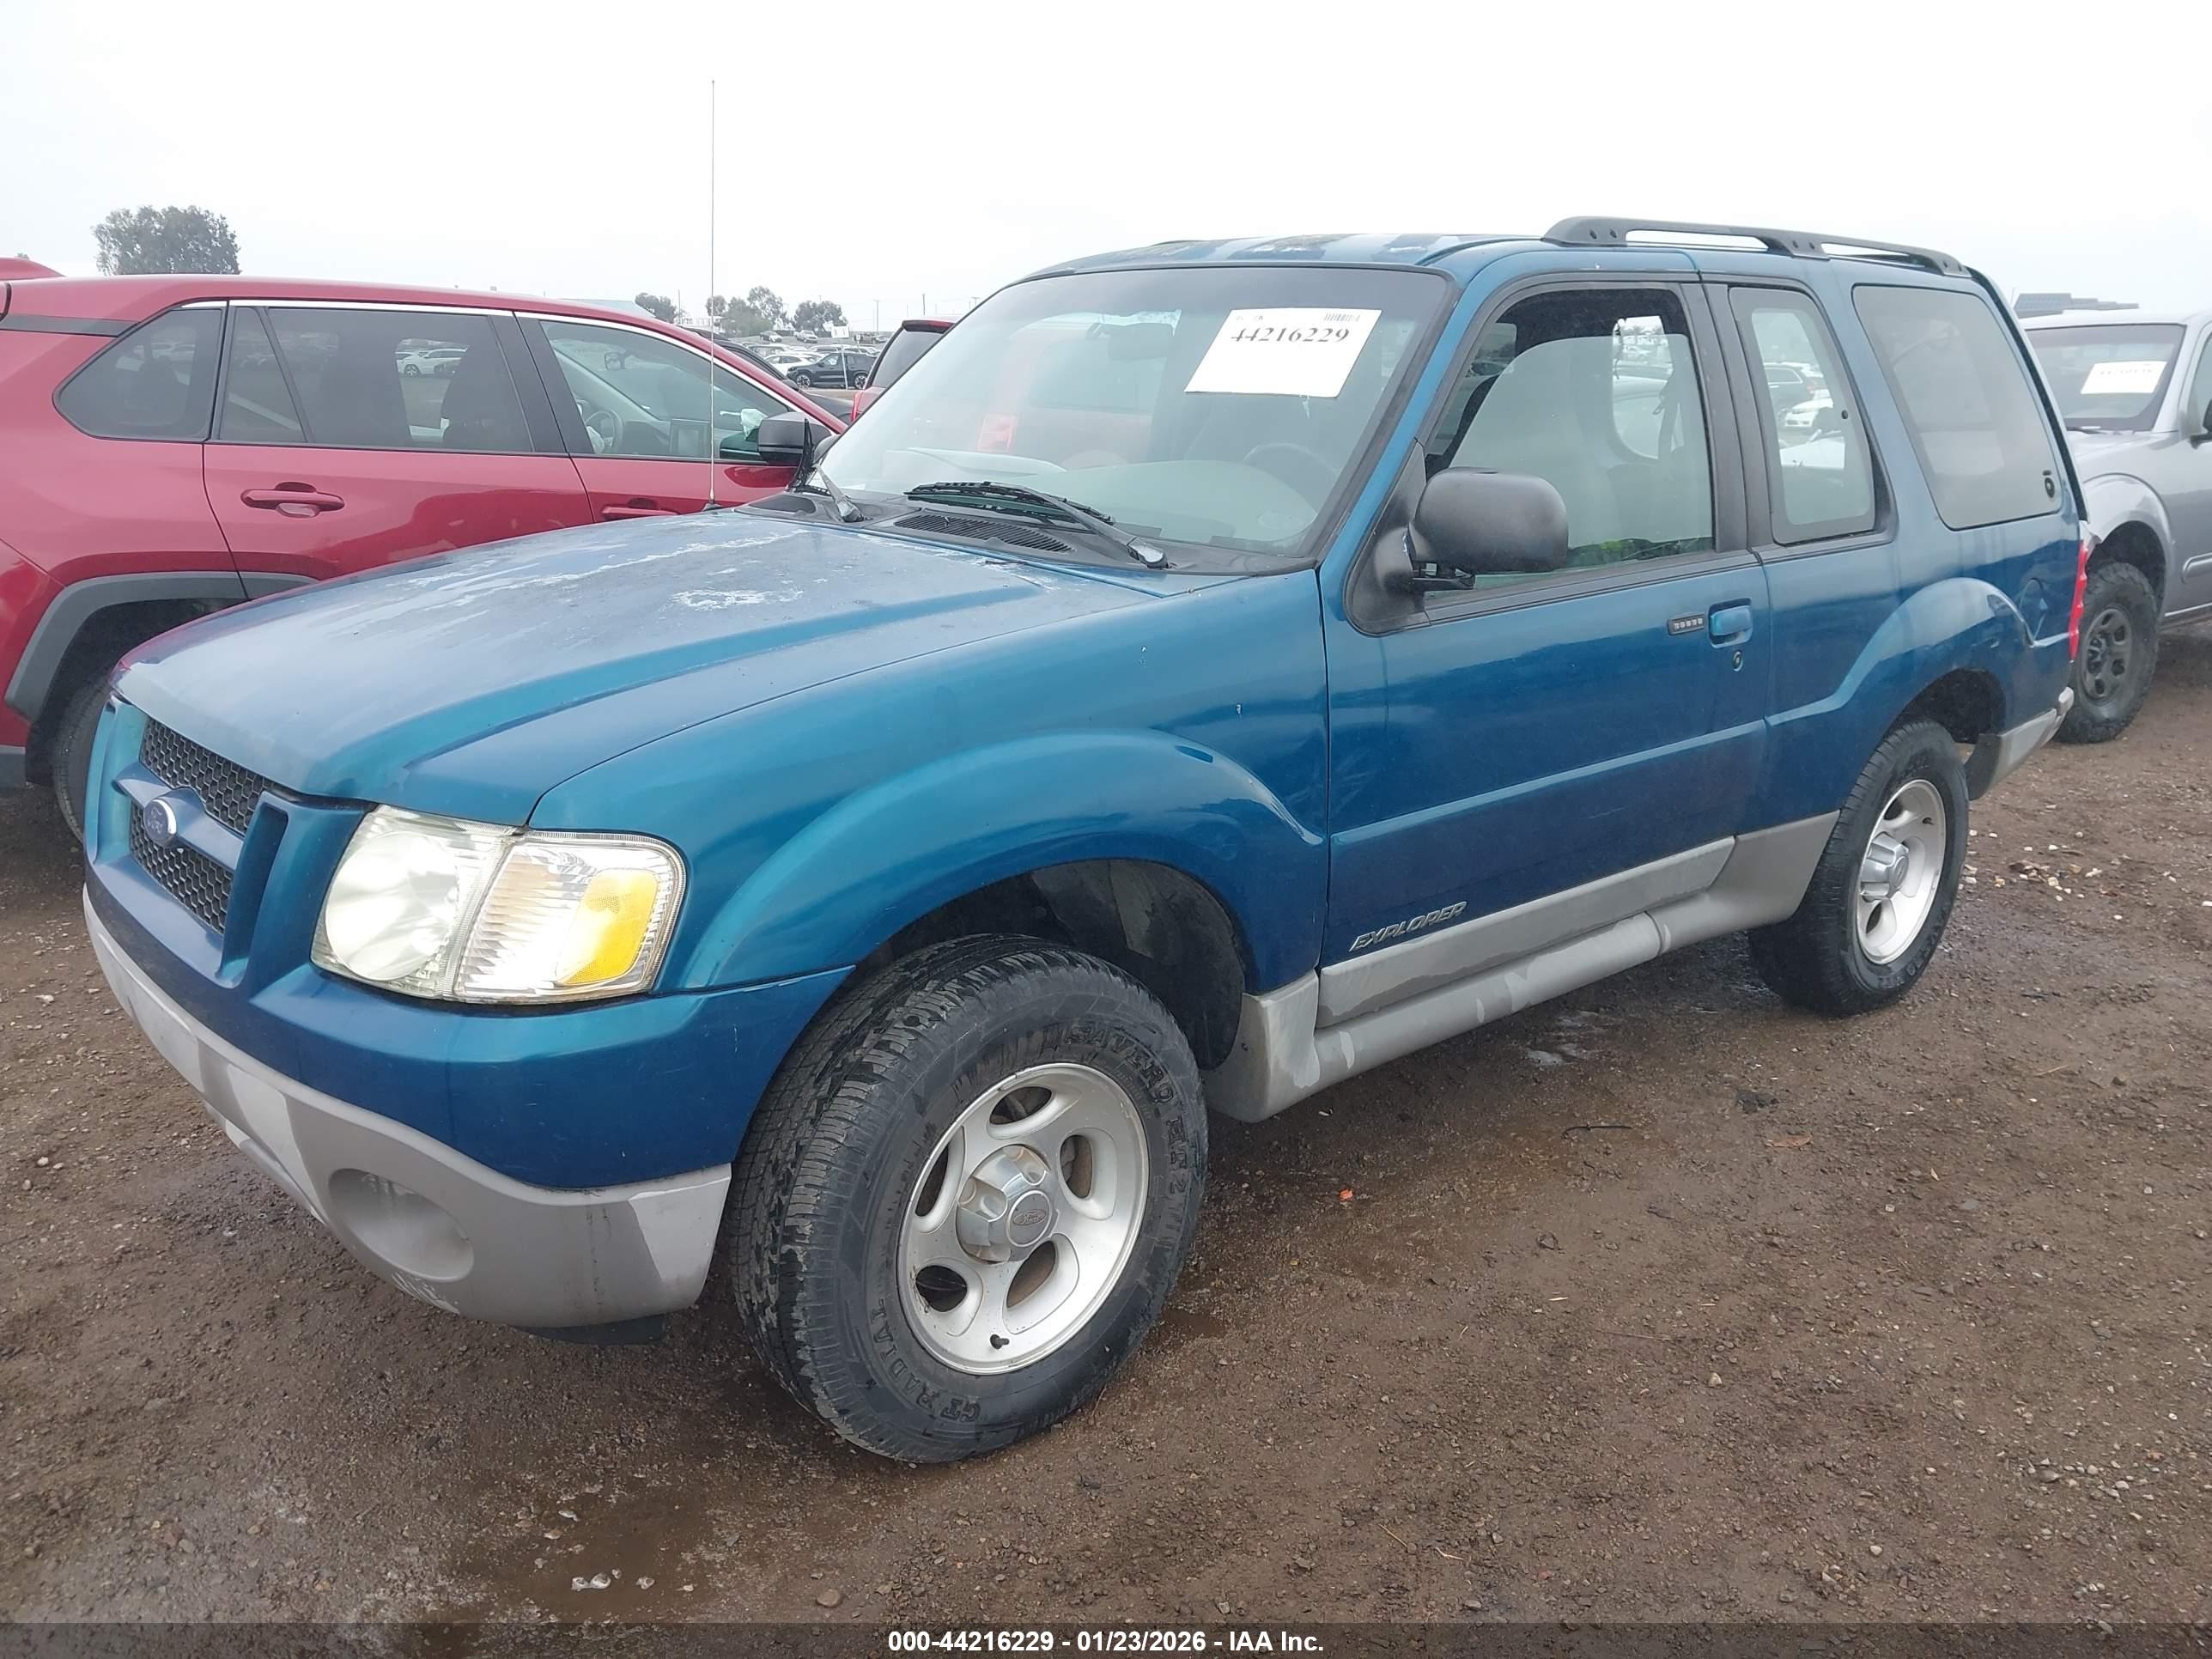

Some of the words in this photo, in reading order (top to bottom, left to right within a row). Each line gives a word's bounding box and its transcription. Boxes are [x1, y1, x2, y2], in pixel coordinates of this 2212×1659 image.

[1231, 327, 1350, 343] 44216229
[1348, 901, 1468, 952] EXPLORER
[870, 1297, 940, 1411] RADIAL
[940, 1396, 981, 1423] GT
